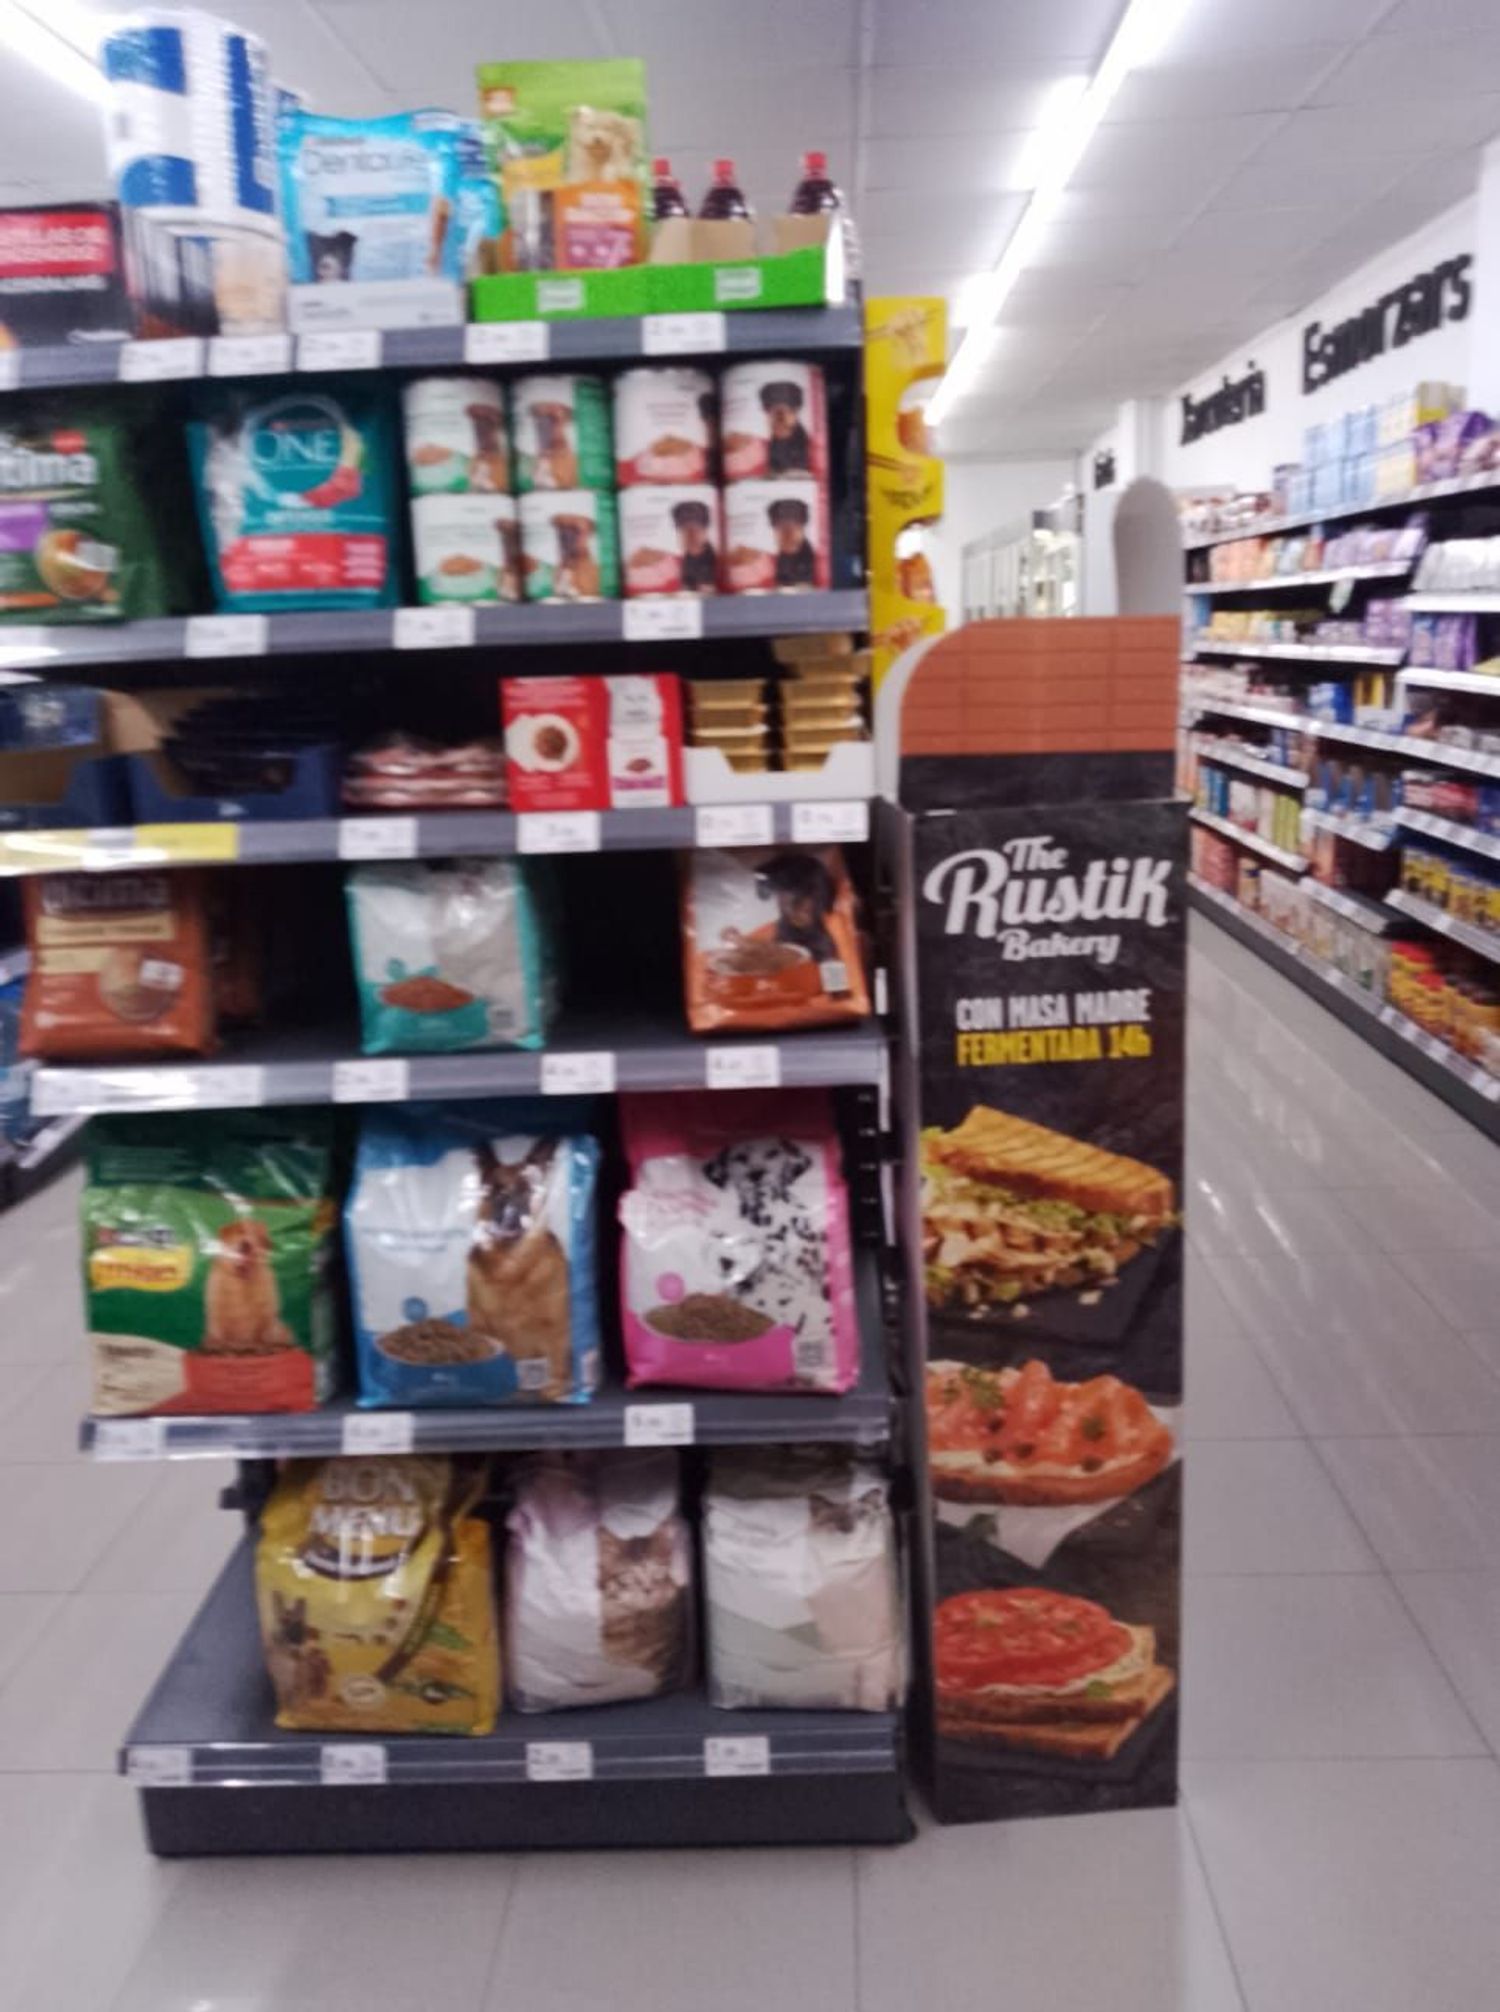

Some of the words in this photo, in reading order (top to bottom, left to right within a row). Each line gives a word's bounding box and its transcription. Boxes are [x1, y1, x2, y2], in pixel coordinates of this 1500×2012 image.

[253, 428, 338, 465] ONE
[1003, 836, 1068, 872] The
[996, 928, 1121, 965] Bakery
[956, 998, 1003, 1031] CON
[1008, 993, 1070, 1028] MASA
[1073, 988, 1152, 1025] MADRE
[957, 1027, 1102, 1067] FERMENTADA
